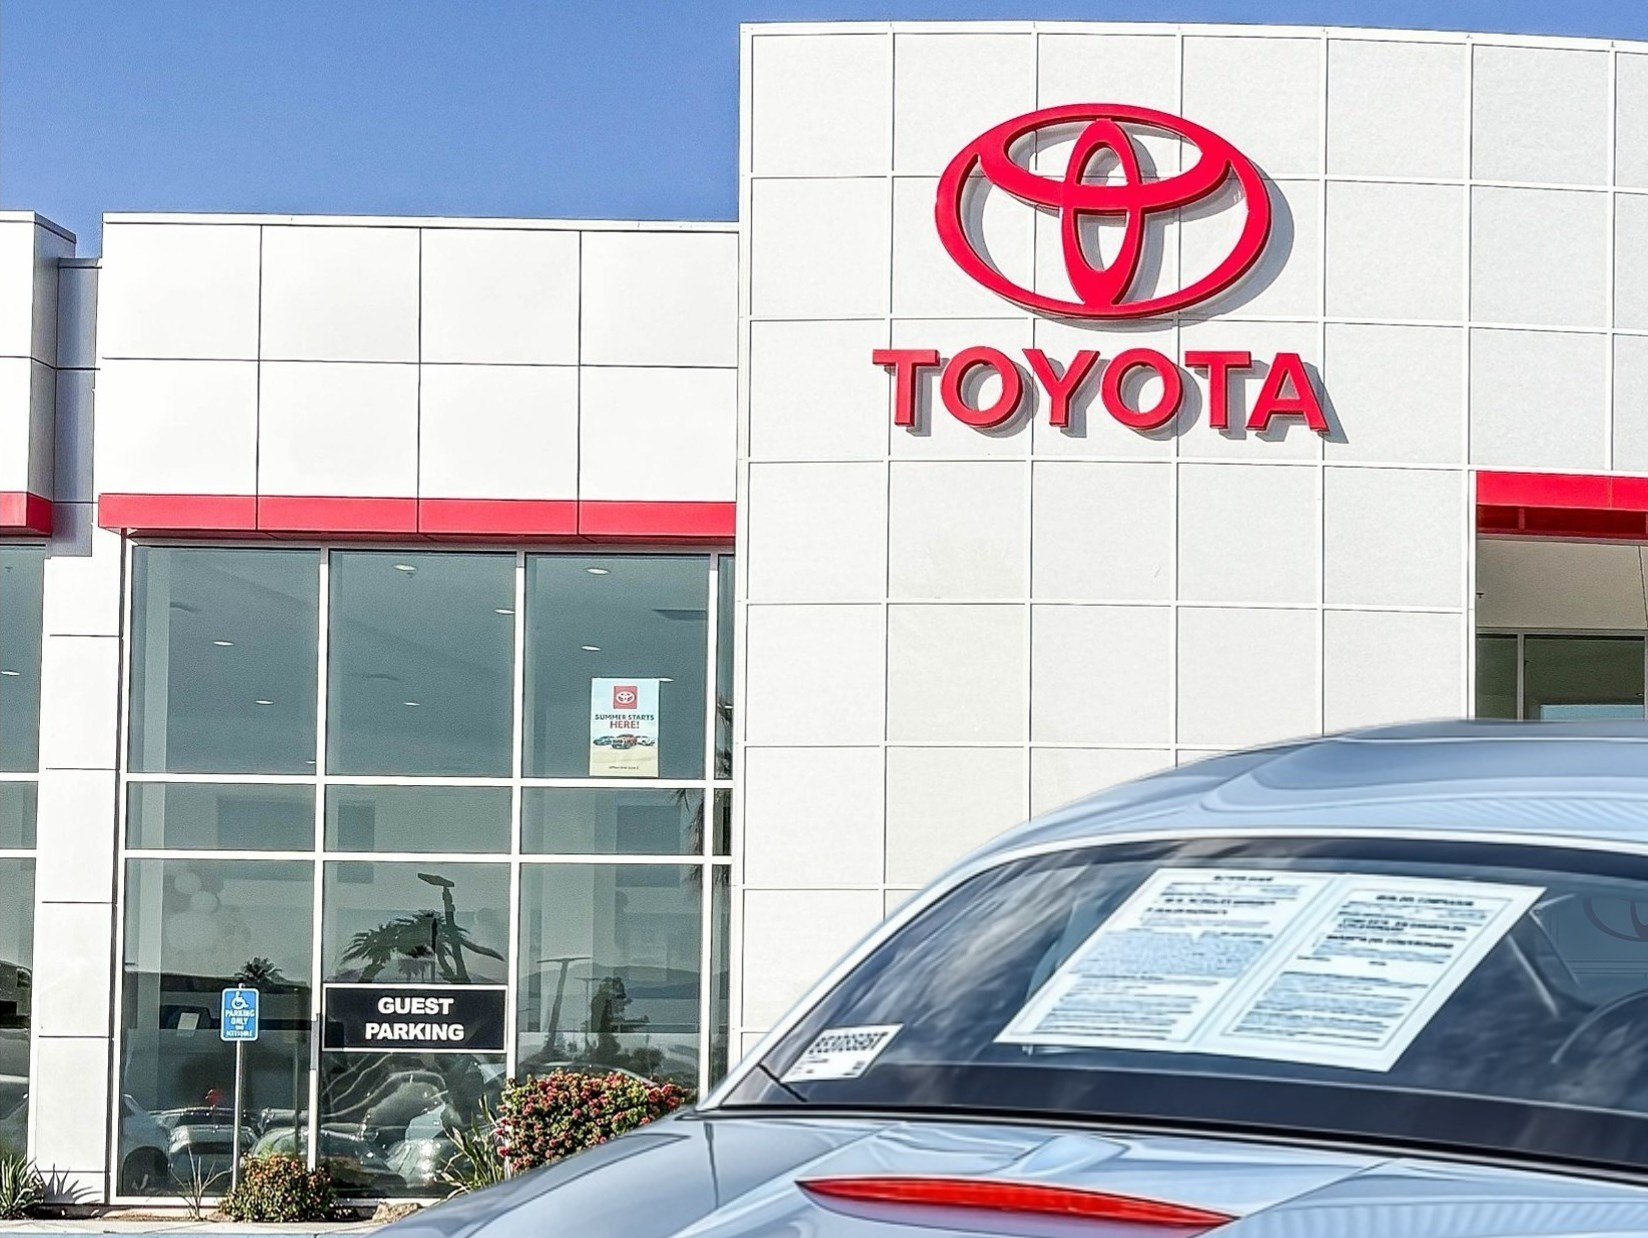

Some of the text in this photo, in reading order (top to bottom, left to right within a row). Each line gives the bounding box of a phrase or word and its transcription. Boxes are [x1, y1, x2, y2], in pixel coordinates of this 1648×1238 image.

[872, 345, 1330, 434] TOYOTA
[594, 713, 655, 721] SUMMER STARTS
[609, 721, 640, 729] HERE!
[377, 996, 455, 1015] GUEST
[365, 1022, 465, 1041] PARKING
